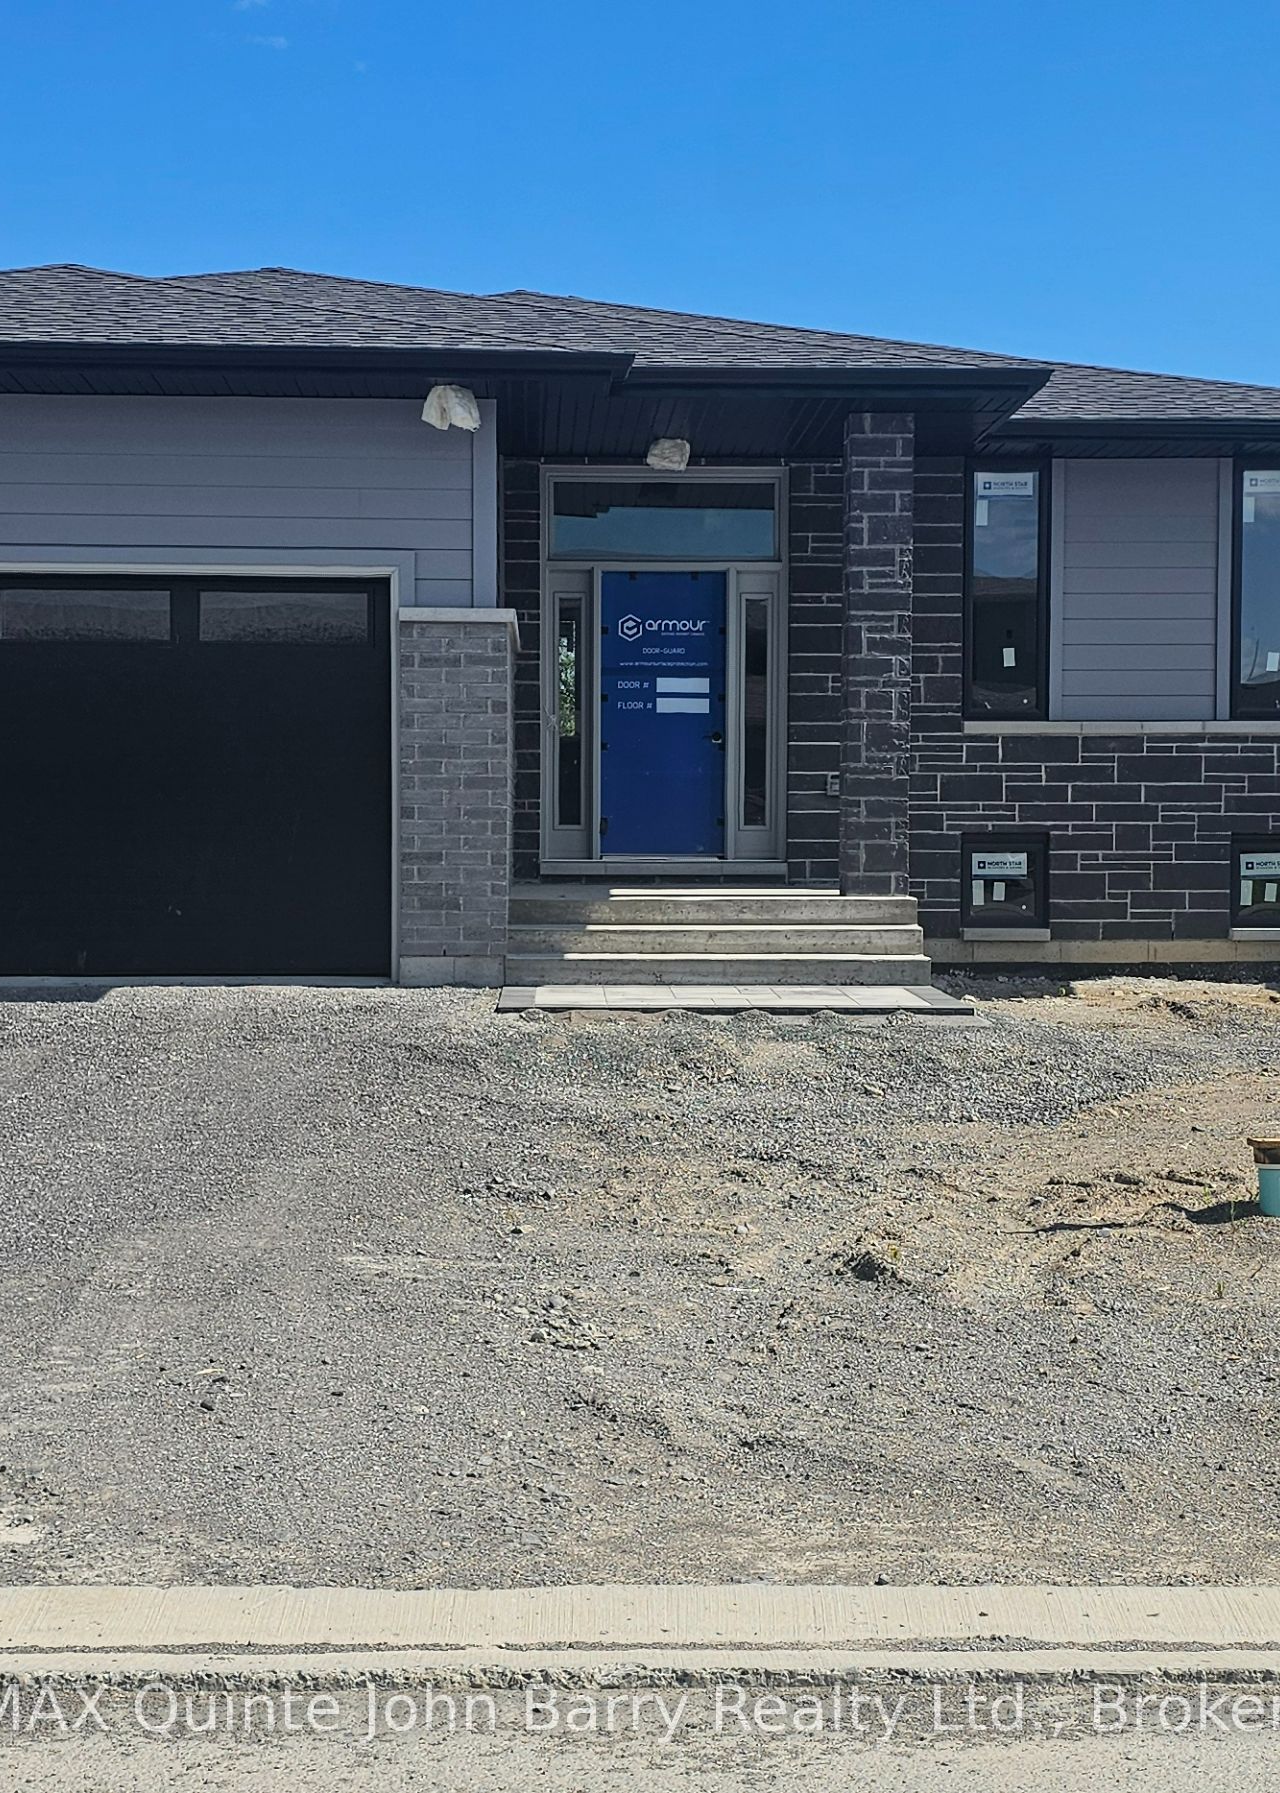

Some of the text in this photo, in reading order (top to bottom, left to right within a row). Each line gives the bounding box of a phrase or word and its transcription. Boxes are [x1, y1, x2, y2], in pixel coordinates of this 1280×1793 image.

[645, 620, 706, 631] armour
[617, 680, 650, 689] DOOR #
[617, 701, 645, 710] FLOOR
